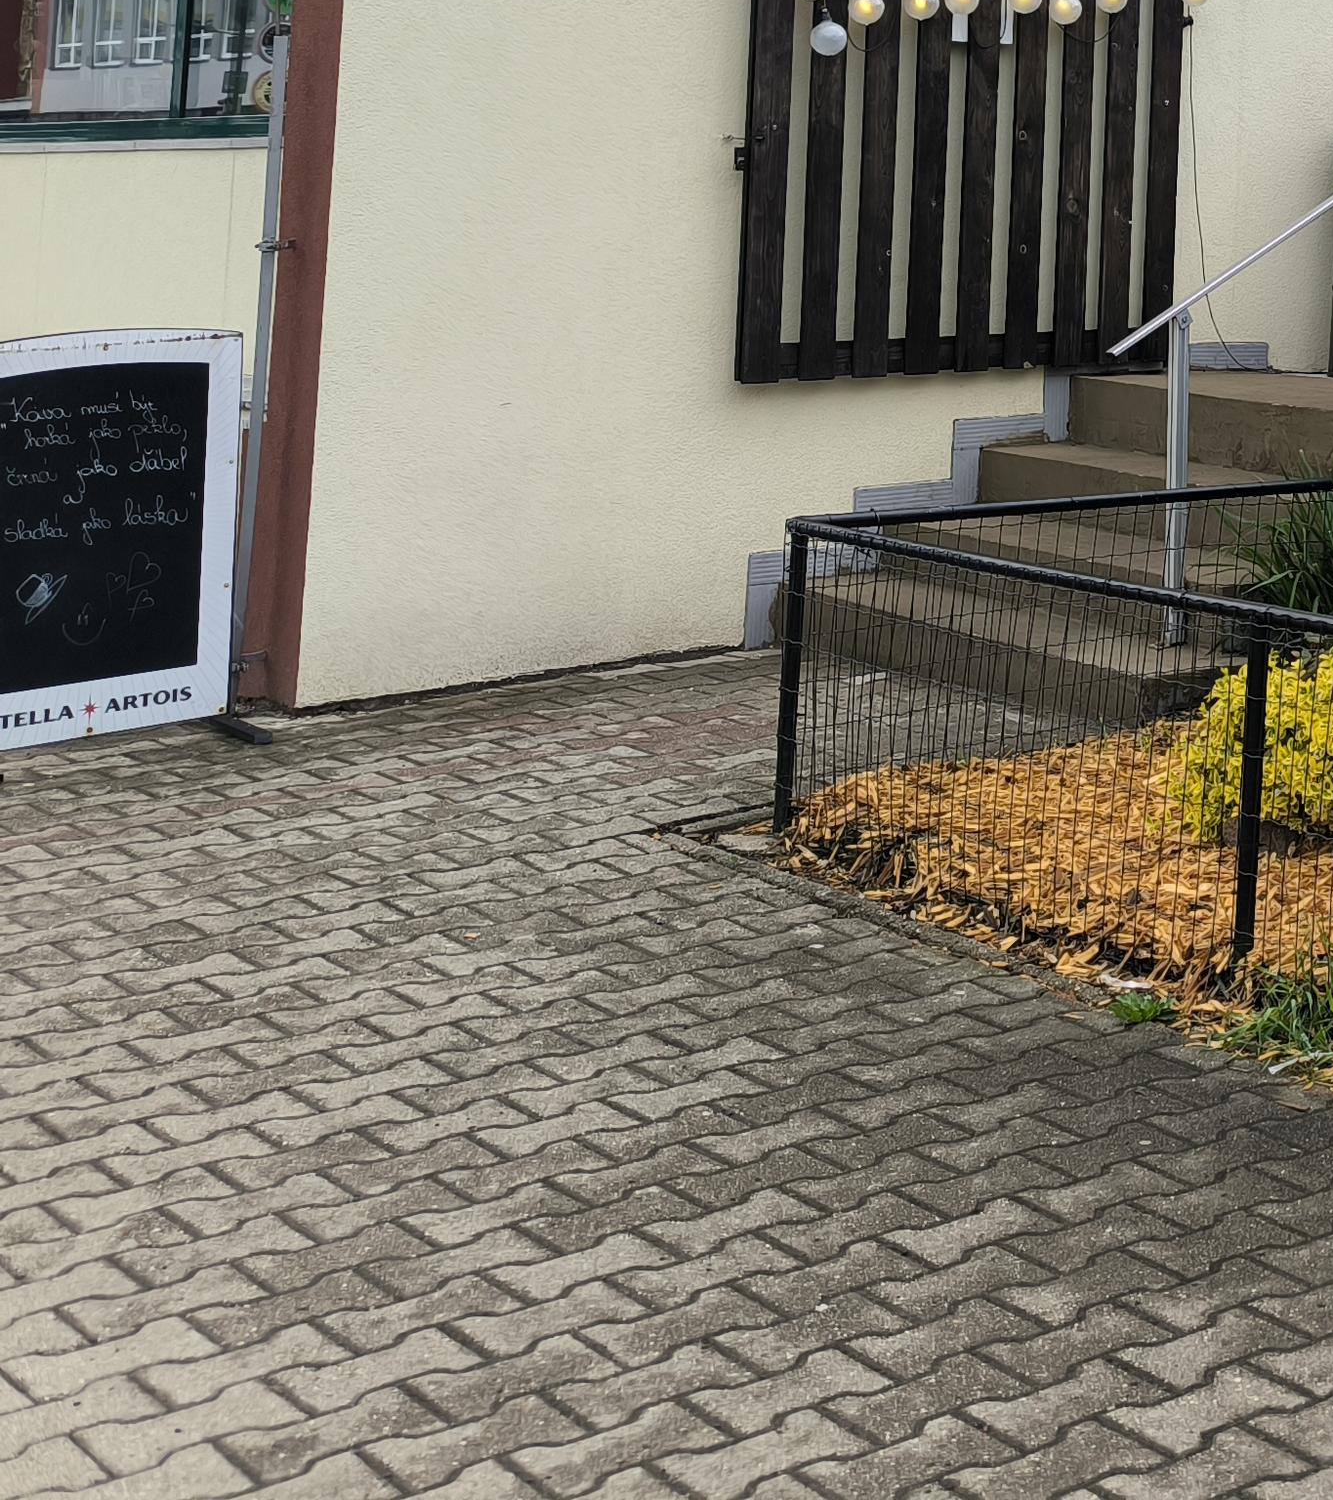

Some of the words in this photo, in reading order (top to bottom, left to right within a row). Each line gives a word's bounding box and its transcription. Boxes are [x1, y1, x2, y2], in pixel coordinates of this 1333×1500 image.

[88, 418, 122, 460] jako
[76, 458, 118, 494] jako
[105, 686, 193, 713] ARTOIS
